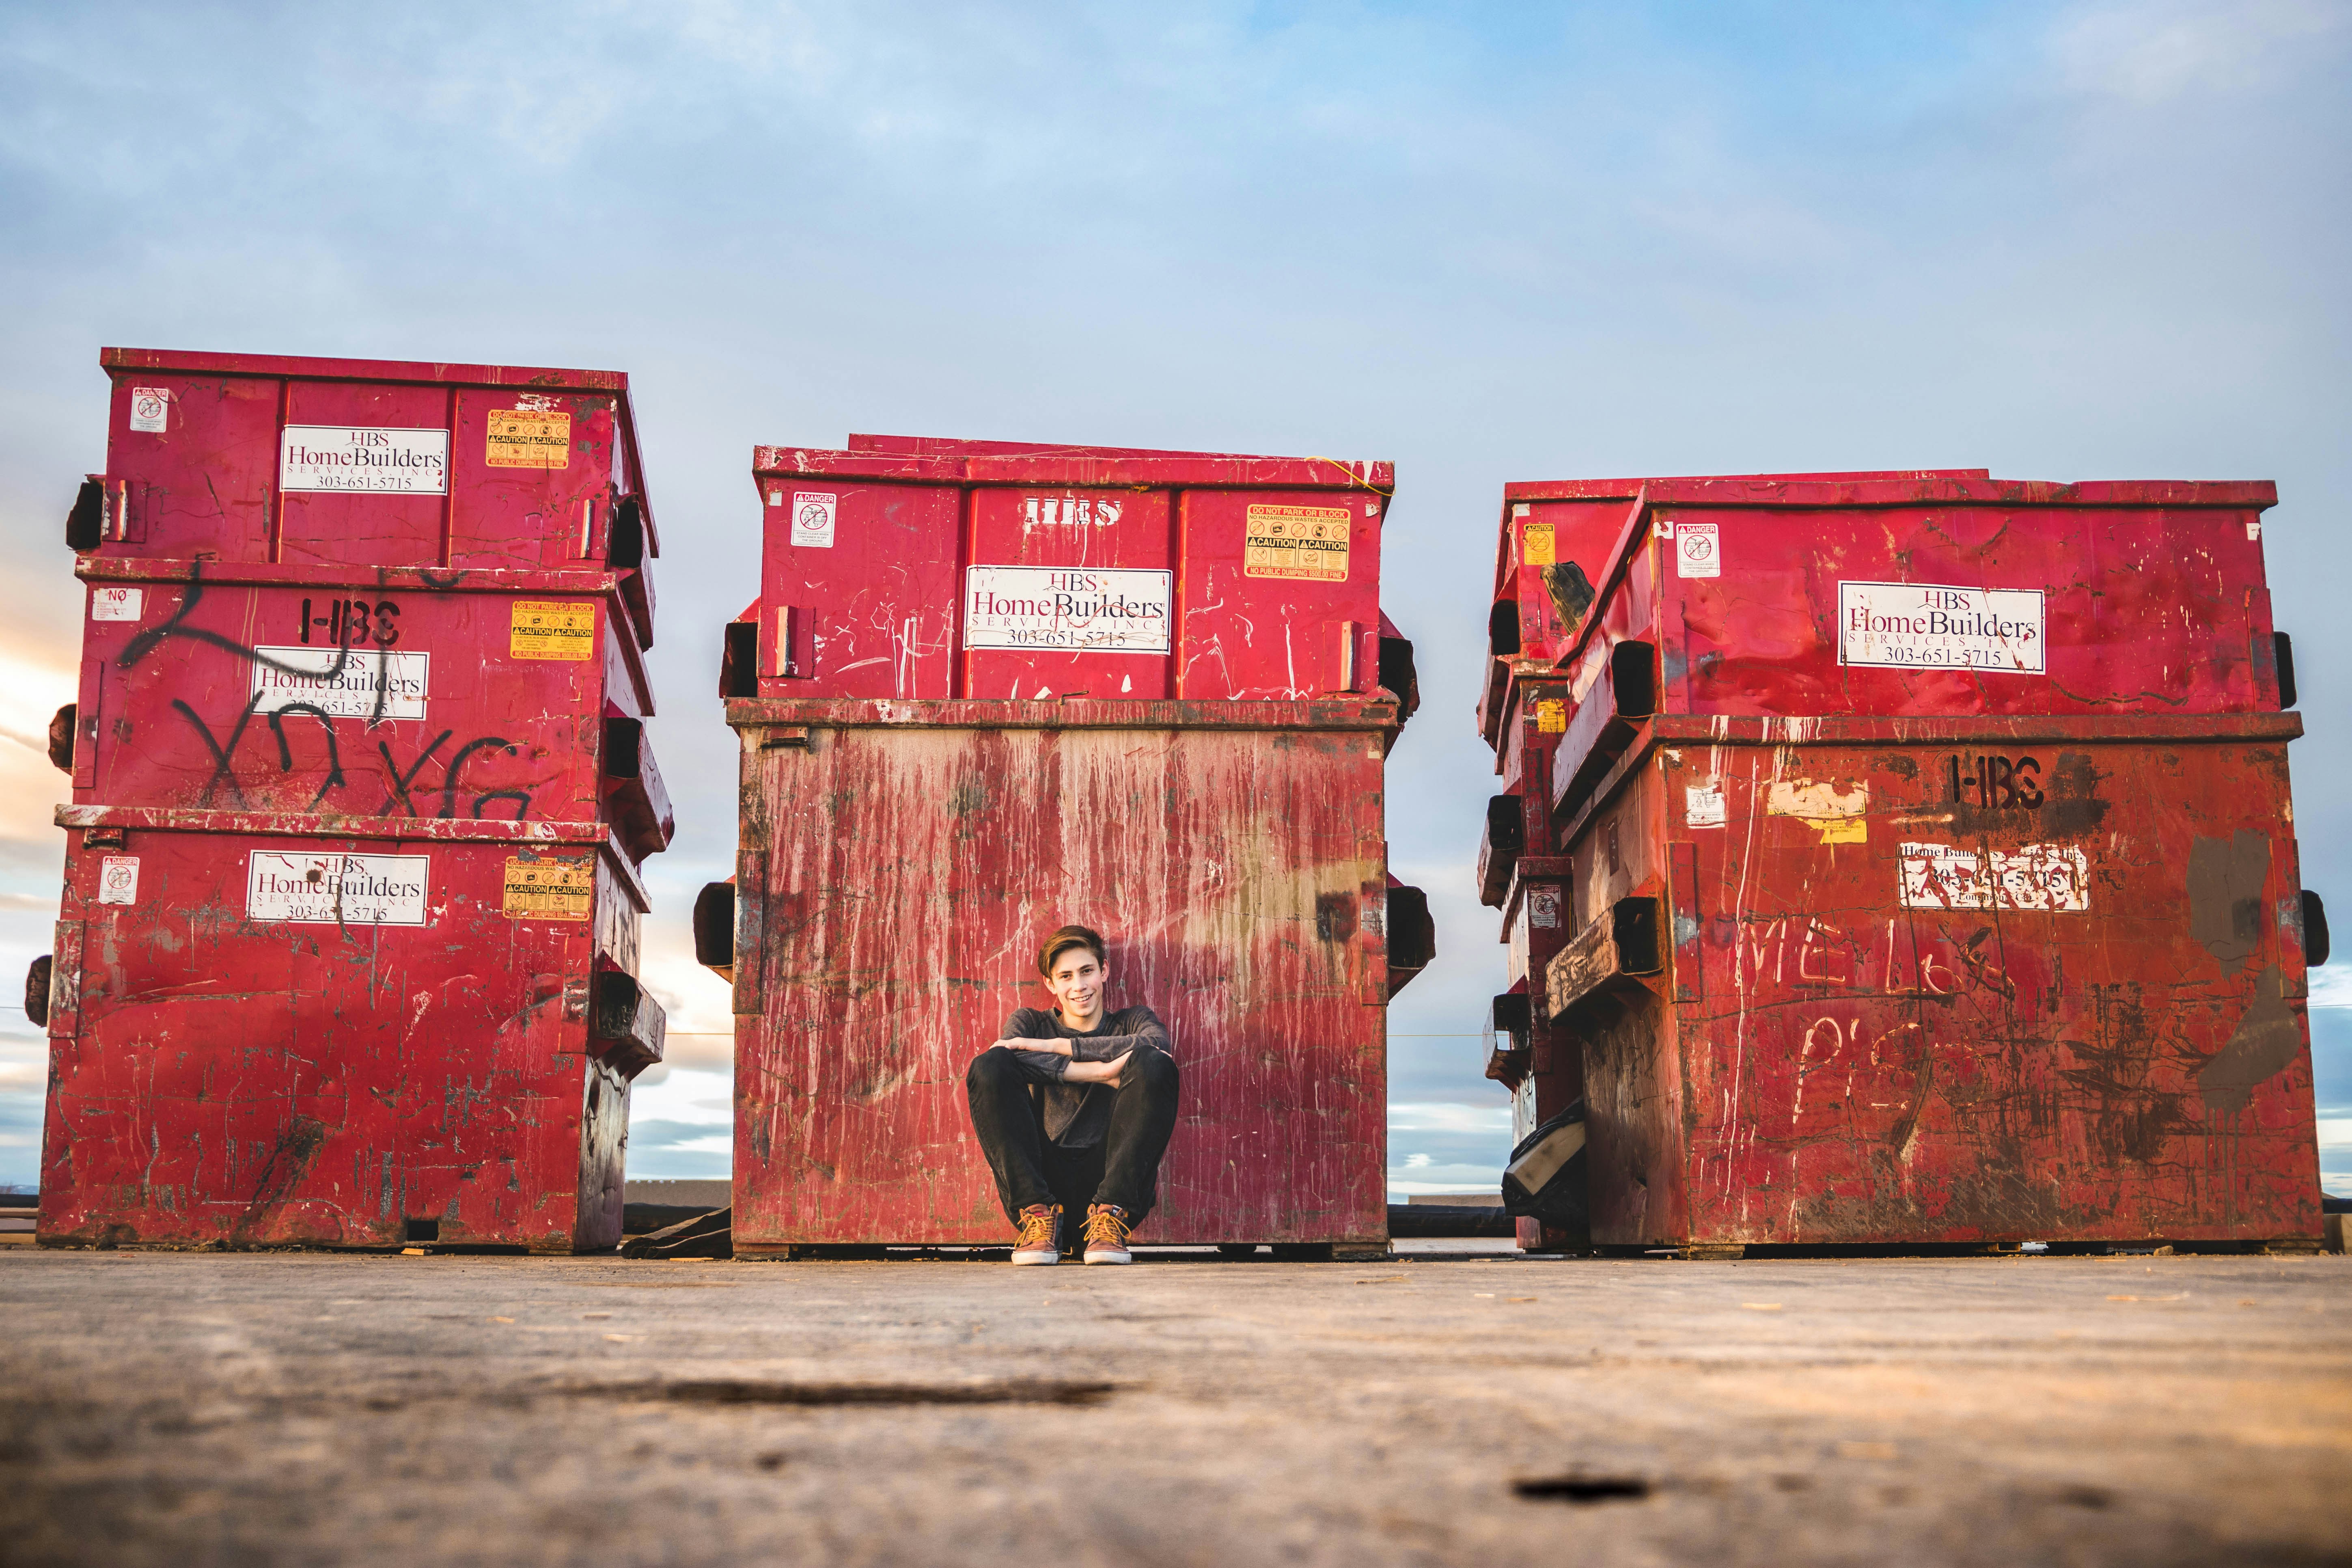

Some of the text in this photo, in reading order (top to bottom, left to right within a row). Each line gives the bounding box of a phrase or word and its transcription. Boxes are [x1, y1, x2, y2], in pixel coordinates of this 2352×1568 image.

[351, 432, 388, 446] HBS
[287, 446, 442, 467] HomeBuilders
[317, 476, 411, 489] 303-651-5715
[1026, 496, 1121, 526] HBS
[1257, 538, 1296, 548] CAUTION
[1308, 541, 1347, 550] CAUTION
[1050, 573, 1097, 591] HBS
[109, 590, 126, 600] NO
[1923, 590, 1970, 610] HBS
[972, 592, 1164, 619] HomeBuilders
[301, 598, 400, 645] HBS
[1849, 608, 2036, 639] HomeBuilders
[1007, 630, 1126, 646] 303-6515715
[326, 654, 365, 669] HBS
[1884, 647, 2001, 665] 303-651-5715
[261, 668, 420, 693] HomeBuilders
[1951, 754, 2044, 810] HBS
[1905, 845, 1940, 857] Home
[325, 858, 364, 874] HBS
[257, 873, 420, 897] HomeBuilders
